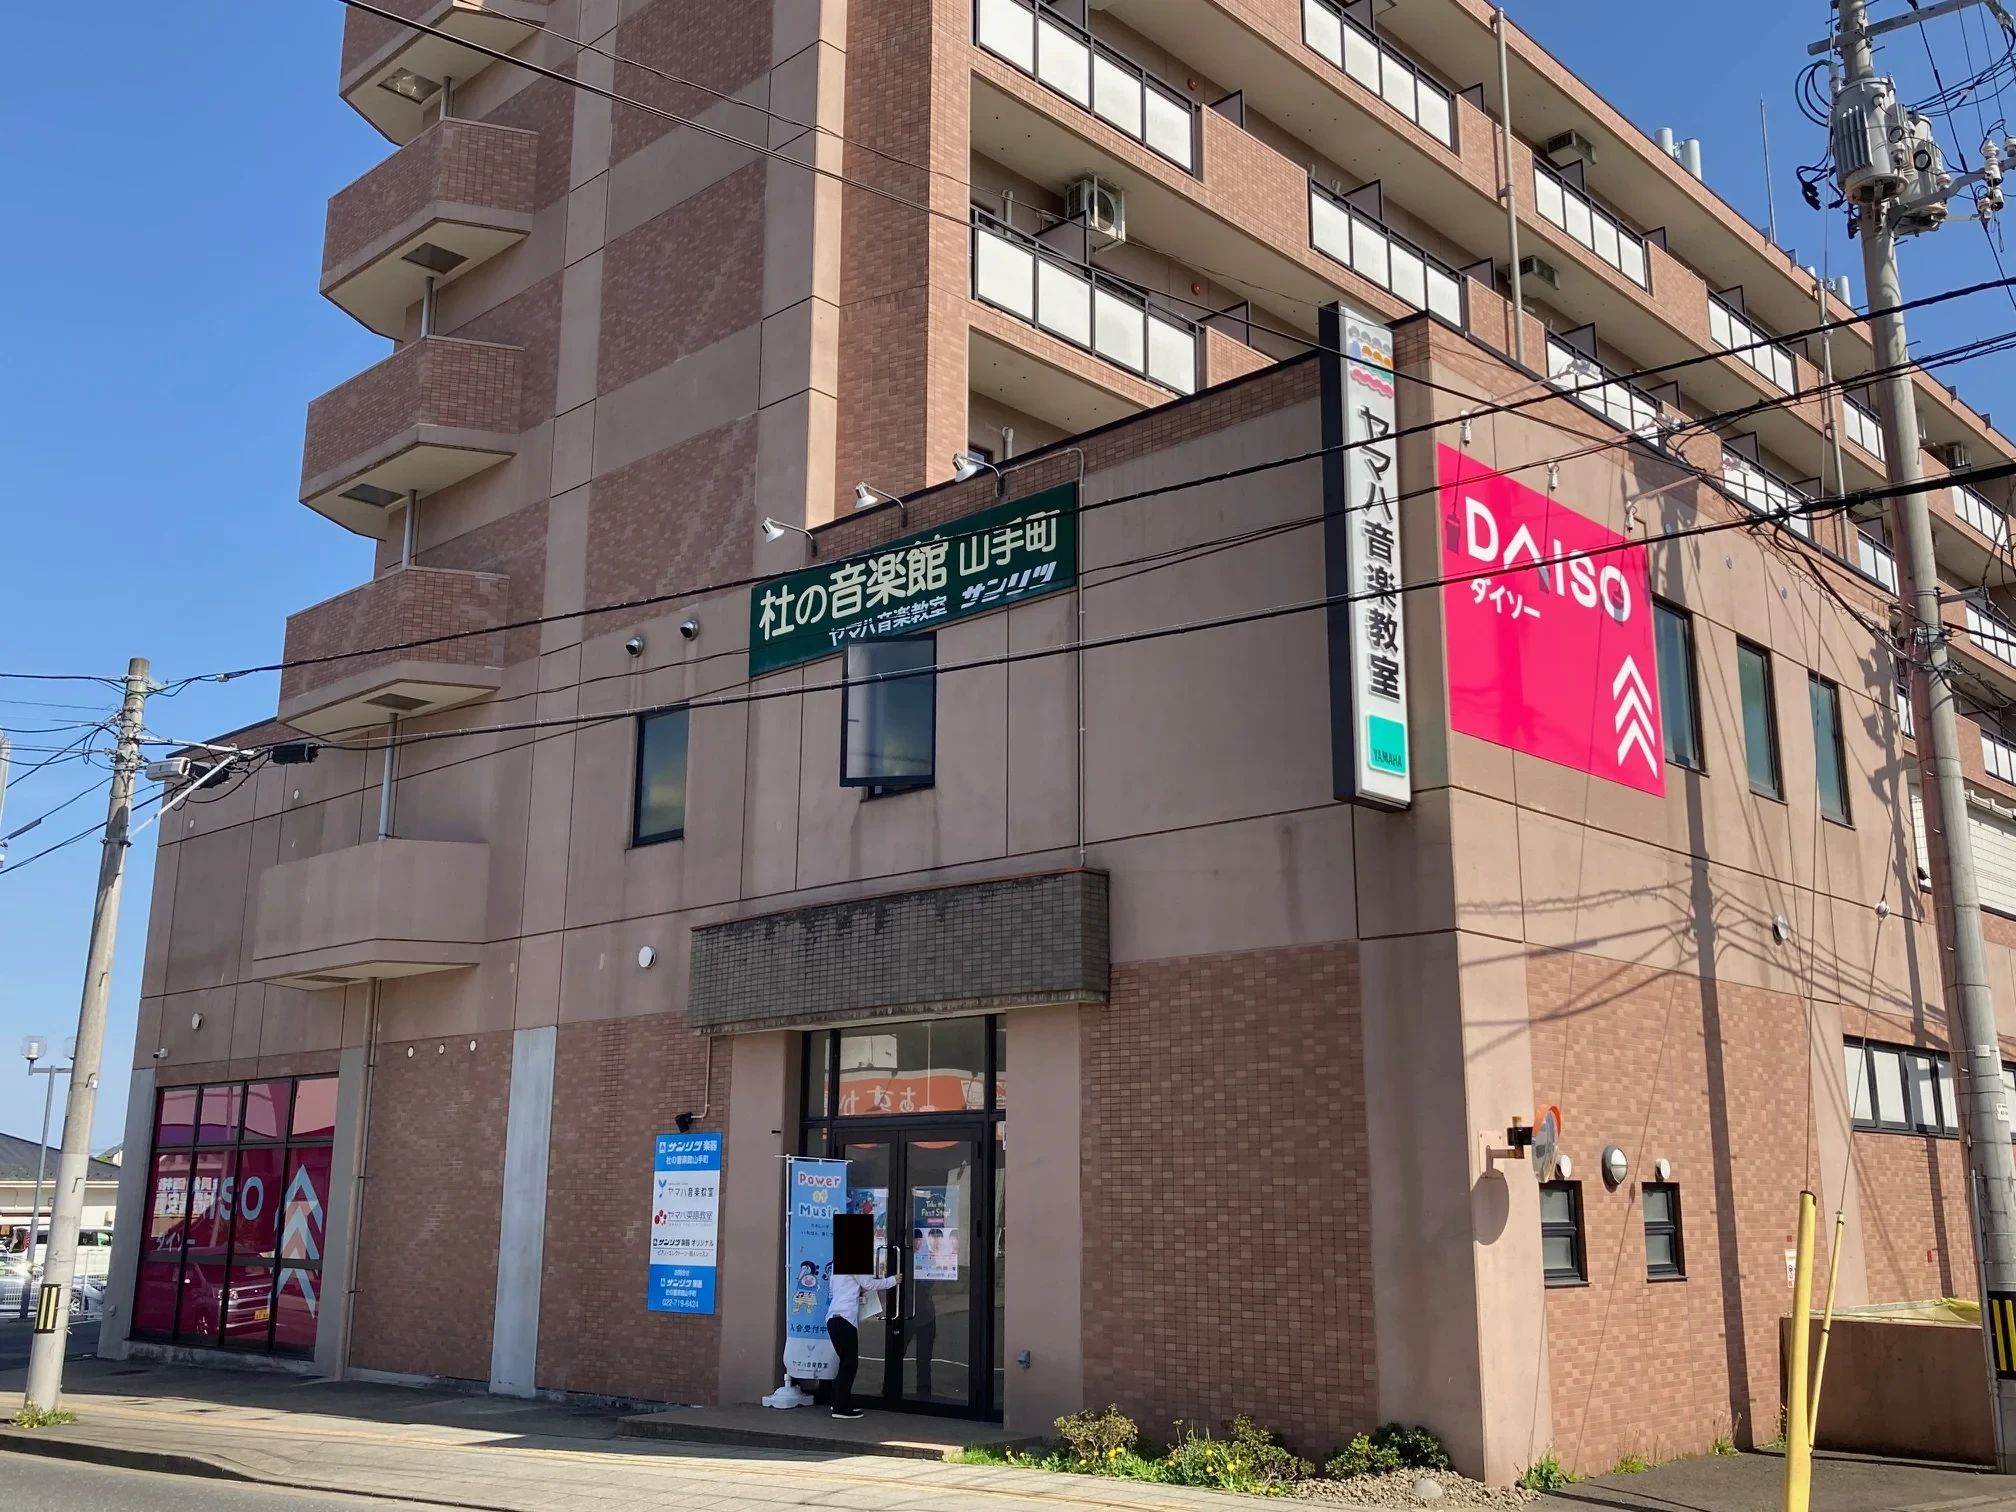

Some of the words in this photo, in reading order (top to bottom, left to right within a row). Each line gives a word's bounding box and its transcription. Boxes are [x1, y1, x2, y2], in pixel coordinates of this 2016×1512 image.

[758, 533, 950, 641] 杜の音楽館
[959, 509, 1061, 577] 山手町
[1357, 404, 1400, 704] ヤマハ音楽教室
[1465, 496, 1632, 623] DAISO
[829, 596, 948, 647] ヤマハ音楽教室
[960, 560, 1058, 610] サンリツ
[1469, 576, 1542, 621] ダイソー
[1373, 748, 1403, 768] YAMAHA
[668, 1187, 714, 1198] ヤマハ音楽教室
[799, 1172, 840, 1187] Power
[814, 1189, 828, 1202] of
